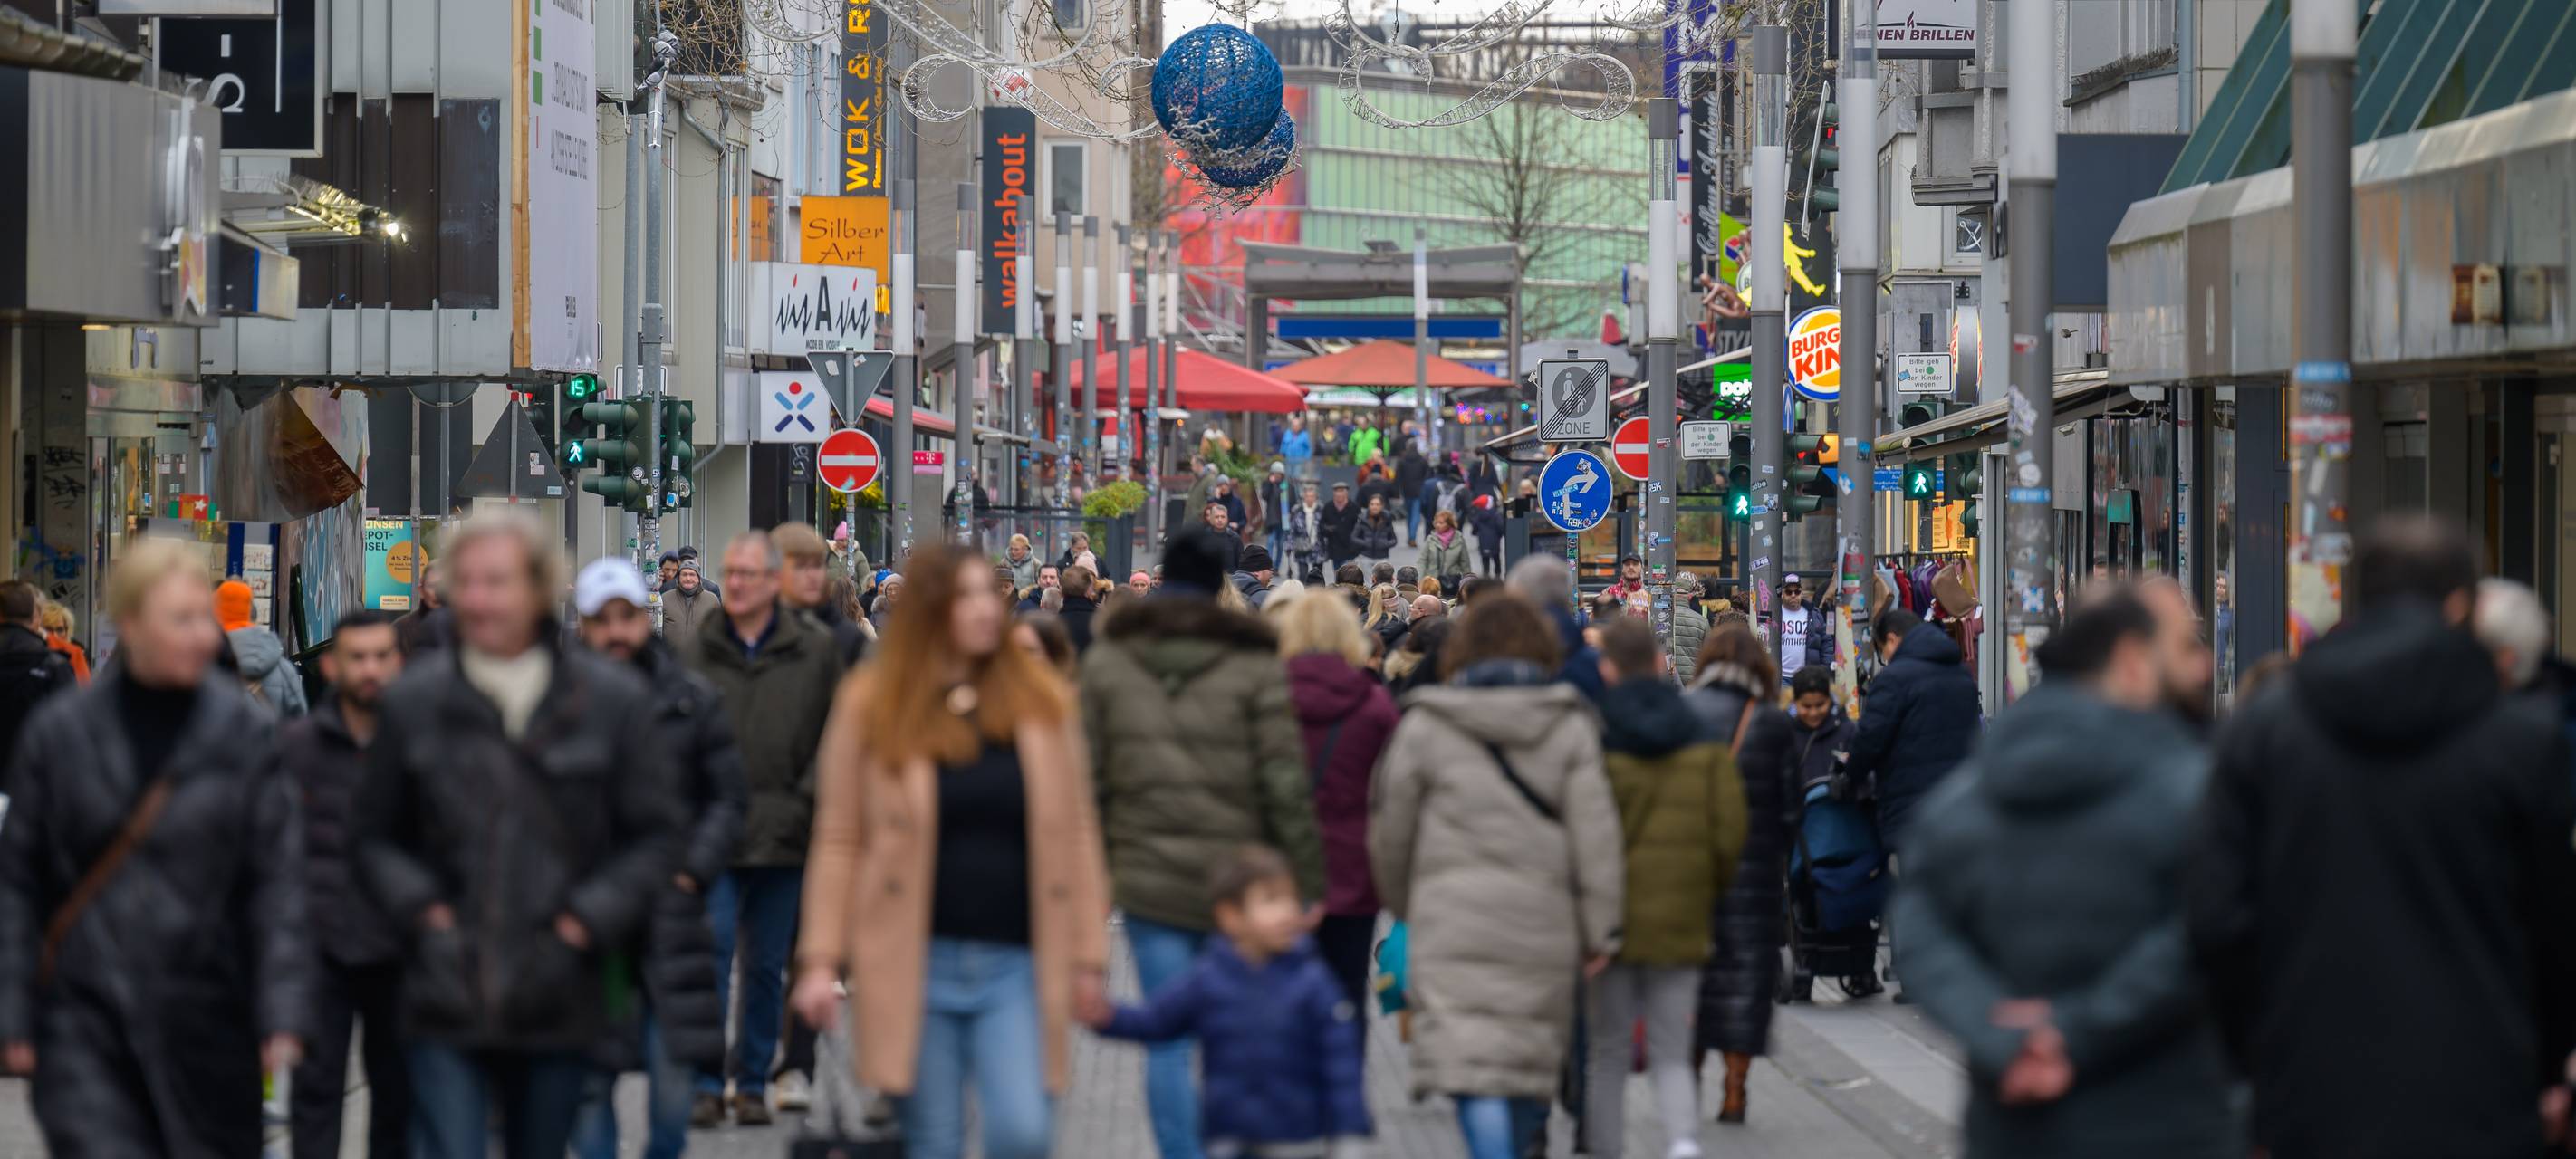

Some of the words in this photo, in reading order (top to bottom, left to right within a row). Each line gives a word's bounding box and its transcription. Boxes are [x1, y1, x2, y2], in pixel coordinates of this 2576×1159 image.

[848, 0, 870, 34] R
[1910, 30, 1975, 40] BRILLEN
[846, 97, 869, 192] WOK
[806, 217, 885, 239] Silber
[994, 133, 1027, 309] walkabout
[817, 242, 865, 264] Art
[1791, 327, 1841, 359] BURG
[1794, 347, 1841, 382] KIN
[572, 380, 584, 396] 15
[1557, 421, 1591, 435] ZONE
